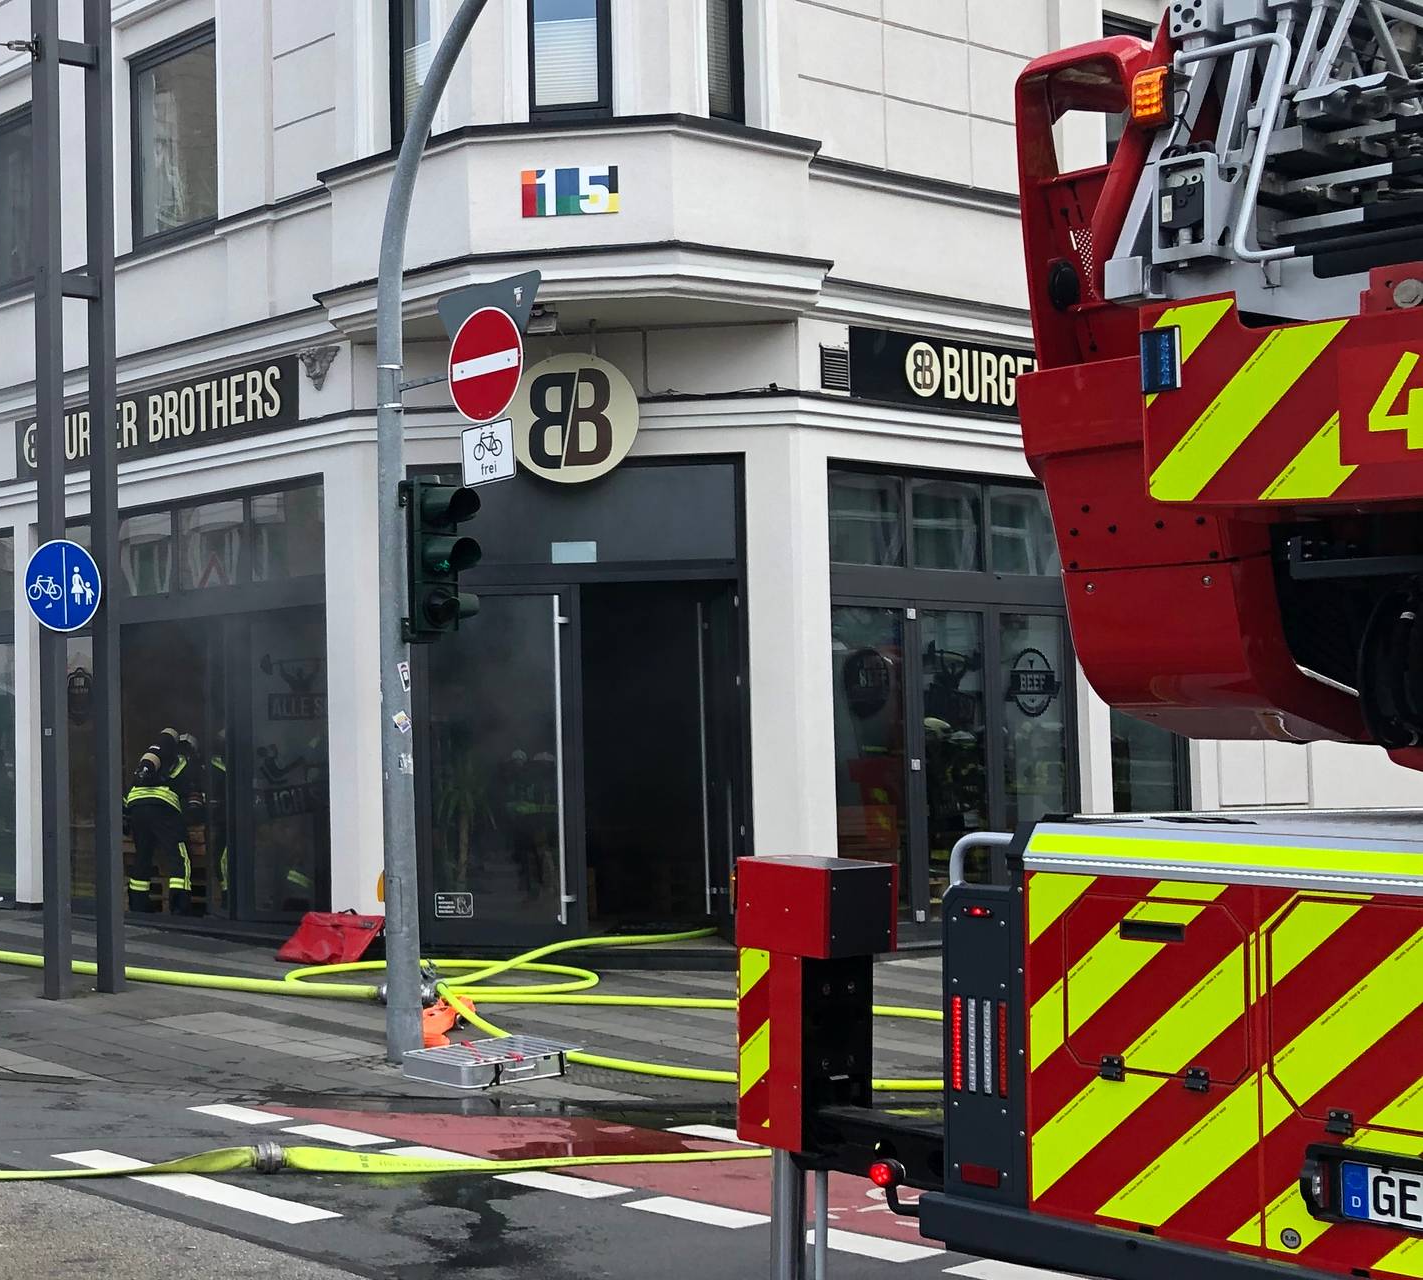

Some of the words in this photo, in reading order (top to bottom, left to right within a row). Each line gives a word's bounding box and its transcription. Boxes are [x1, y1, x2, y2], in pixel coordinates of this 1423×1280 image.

[536, 167, 609, 216] 15
[943, 346, 1038, 406] BURG
[148, 366, 280, 443] BROTHERS
[481, 460, 497, 475] frei
[1020, 673, 1045, 691] BEEF
[1352, 1196, 1361, 1208] D
[1373, 1176, 1422, 1222] GE
